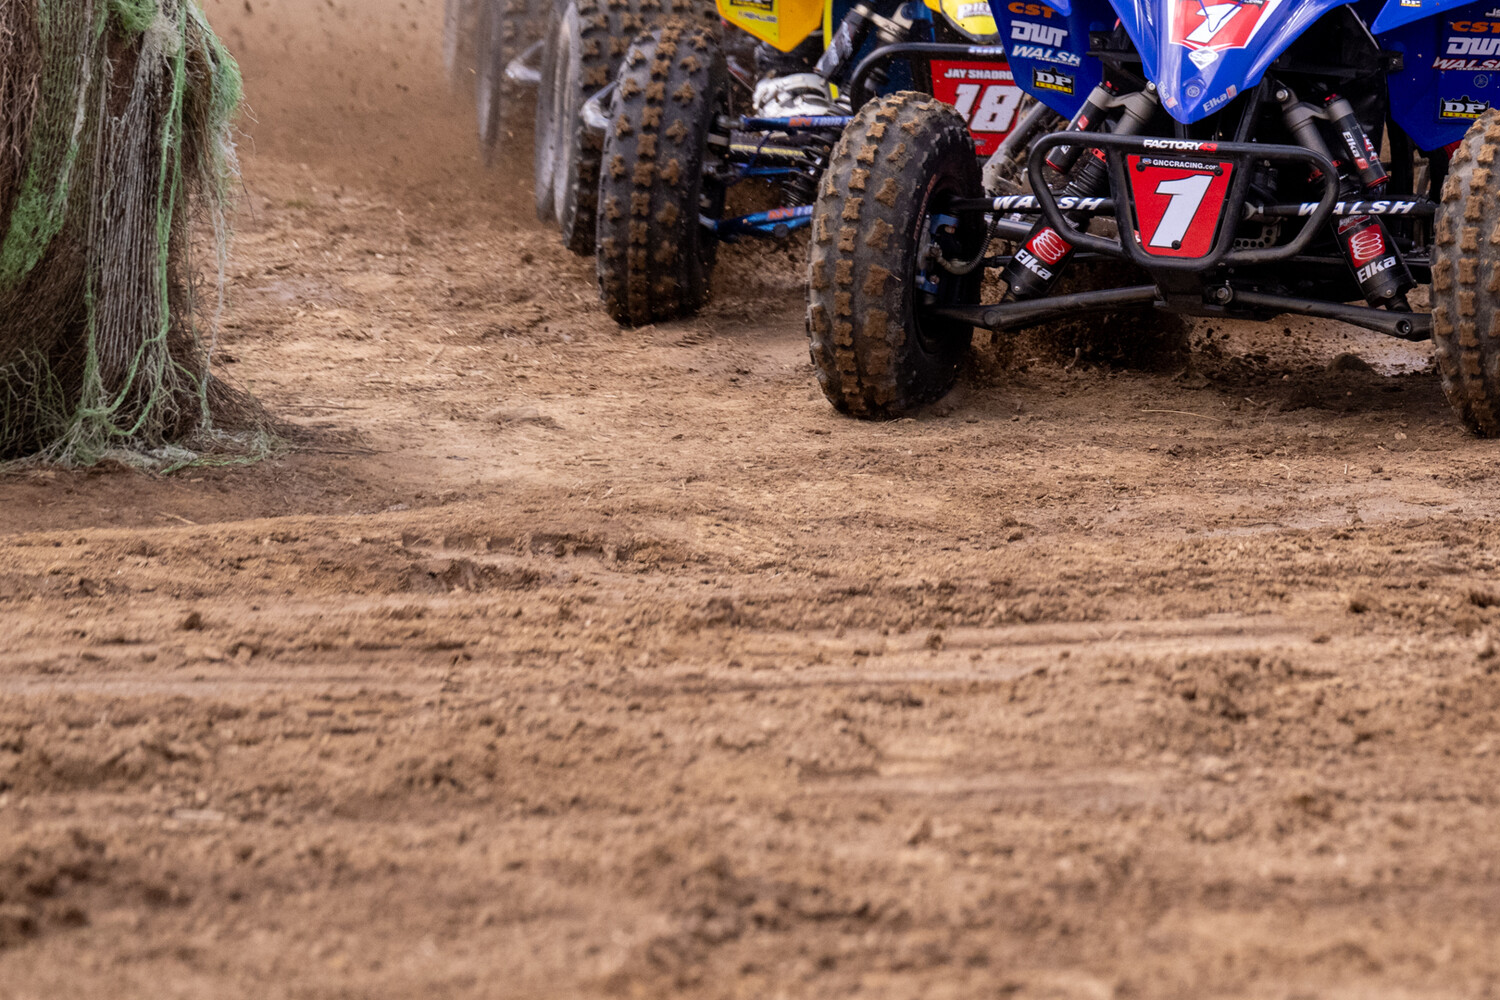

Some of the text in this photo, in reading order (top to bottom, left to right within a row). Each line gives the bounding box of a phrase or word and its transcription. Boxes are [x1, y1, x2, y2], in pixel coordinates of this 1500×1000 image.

[957, 3, 994, 20] PIER
[1008, 1, 1058, 19] CST
[1184, 2, 1244, 44] 1
[1010, 20, 1069, 49] DWT
[1012, 45, 1082, 66] WALSH
[944, 68, 1014, 82] JAY SHADRO
[1035, 71, 1073, 87] DP
[955, 83, 1025, 133] 18
[1202, 91, 1228, 113] Elka
[1443, 101, 1487, 115] DP
[1443, 111, 1483, 120] BRAKE
[1341, 130, 1361, 159] Elka
[993, 194, 1106, 211] WASH
[1149, 173, 1214, 250] 1
[1297, 199, 1418, 216] WALSH
[1013, 247, 1054, 282] Elka
[1355, 254, 1398, 285] Elka
